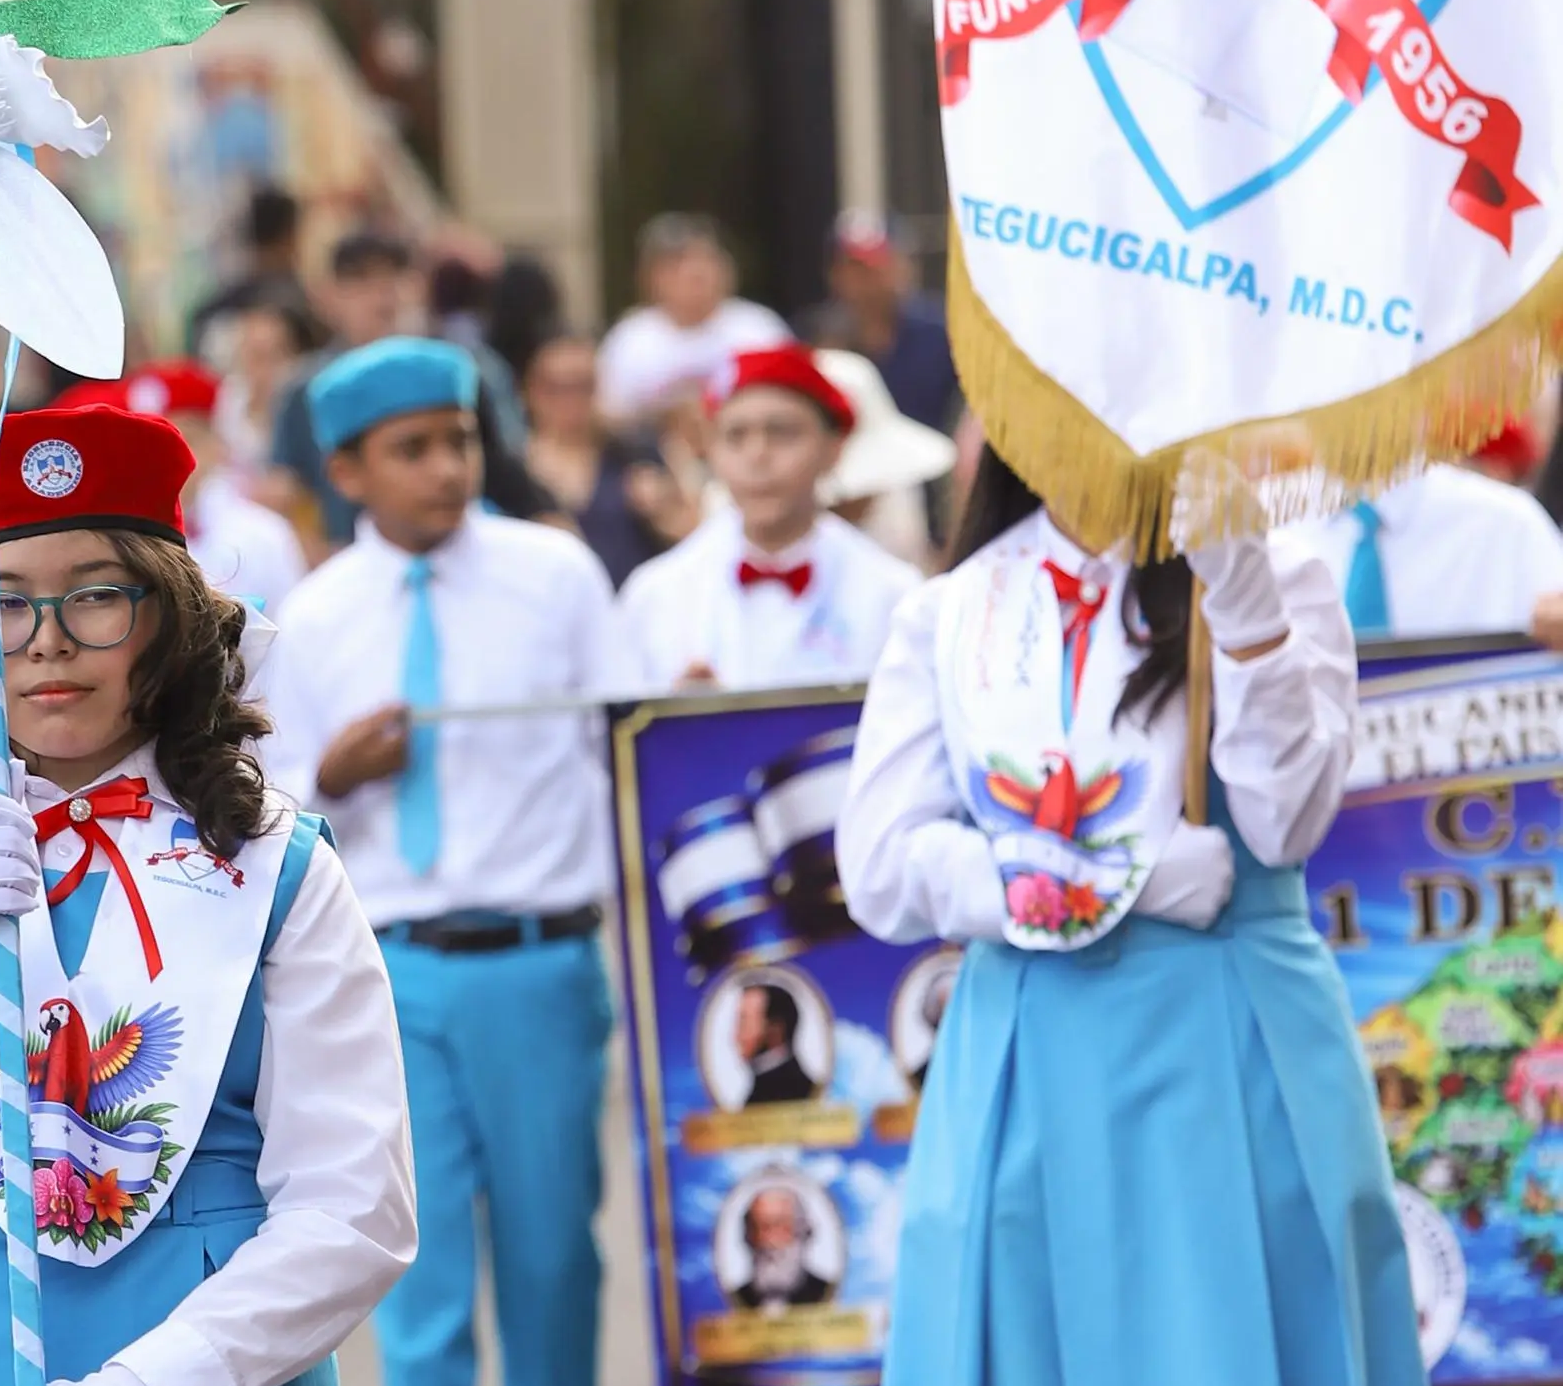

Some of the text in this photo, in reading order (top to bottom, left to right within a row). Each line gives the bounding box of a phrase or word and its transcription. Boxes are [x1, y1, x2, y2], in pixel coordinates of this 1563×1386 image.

[1365, 6, 1489, 144] 1956
[960, 193, 1426, 344] TEGUCIGALPA, M.D.C.
[1427, 782, 1563, 856] C.
